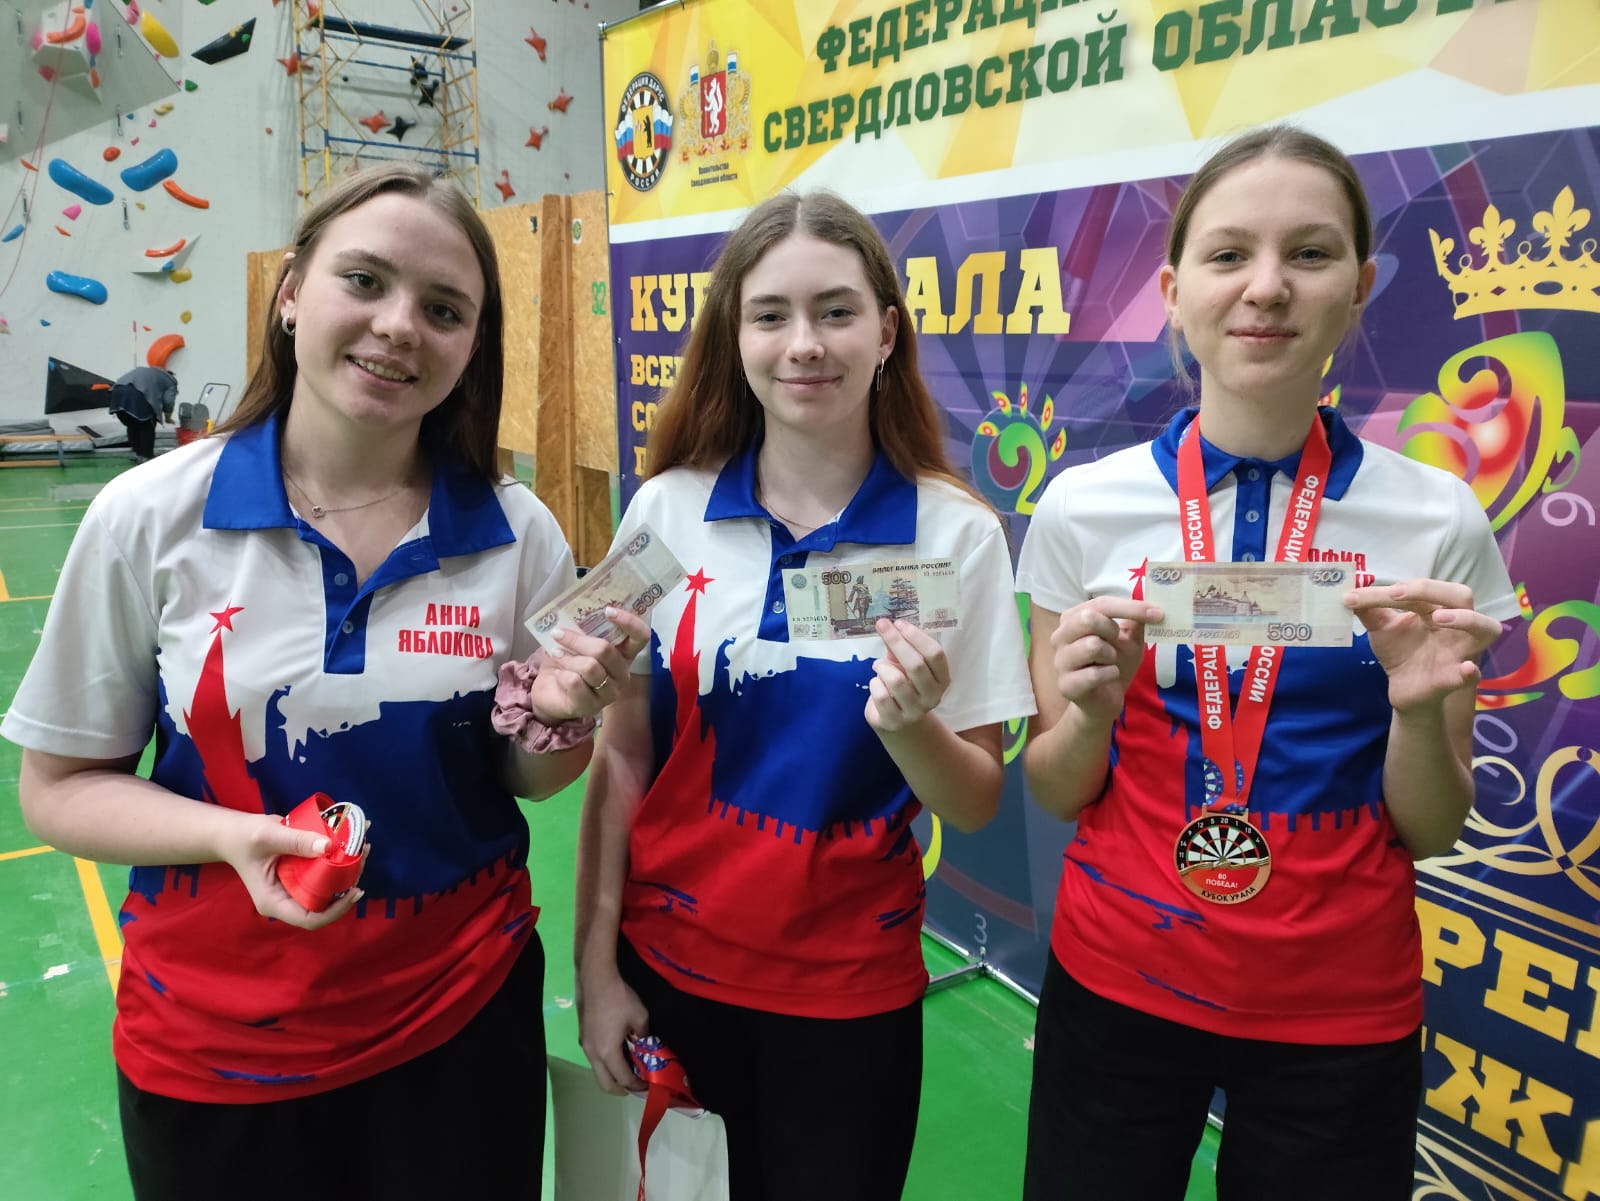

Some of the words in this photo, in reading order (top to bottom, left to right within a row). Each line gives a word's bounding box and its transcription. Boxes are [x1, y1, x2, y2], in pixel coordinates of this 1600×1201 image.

[816, 0, 1094, 73] ФЕДЕРАЦ
[763, 9, 1128, 153] СВЕРДЛОВСКОЙ
[1152, 0, 1475, 72] ОБЛА
[905, 247, 1071, 334] АЛА
[630, 354, 684, 388] ВСЕ
[1186, 499, 1205, 561] РОССИИ
[1284, 475, 1319, 562] ФЕДЕРАЦИ
[1150, 569, 1181, 583] 500
[1307, 548, 1366, 571] ОФИЯ
[1311, 568, 1344, 584] 500
[821, 571, 852, 585] 500
[425, 603, 480, 628] АННА
[632, 583, 663, 616] 500
[398, 629, 494, 659] ЯБЛОКОВА
[1267, 622, 1312, 641] 500
[1202, 646, 1223, 730] ФЕДЕРАЦ
[1248, 645, 1276, 703] ОССИИ
[1201, 890, 1229, 902] КУБОК
[1230, 886, 1256, 902] УРАЛА
